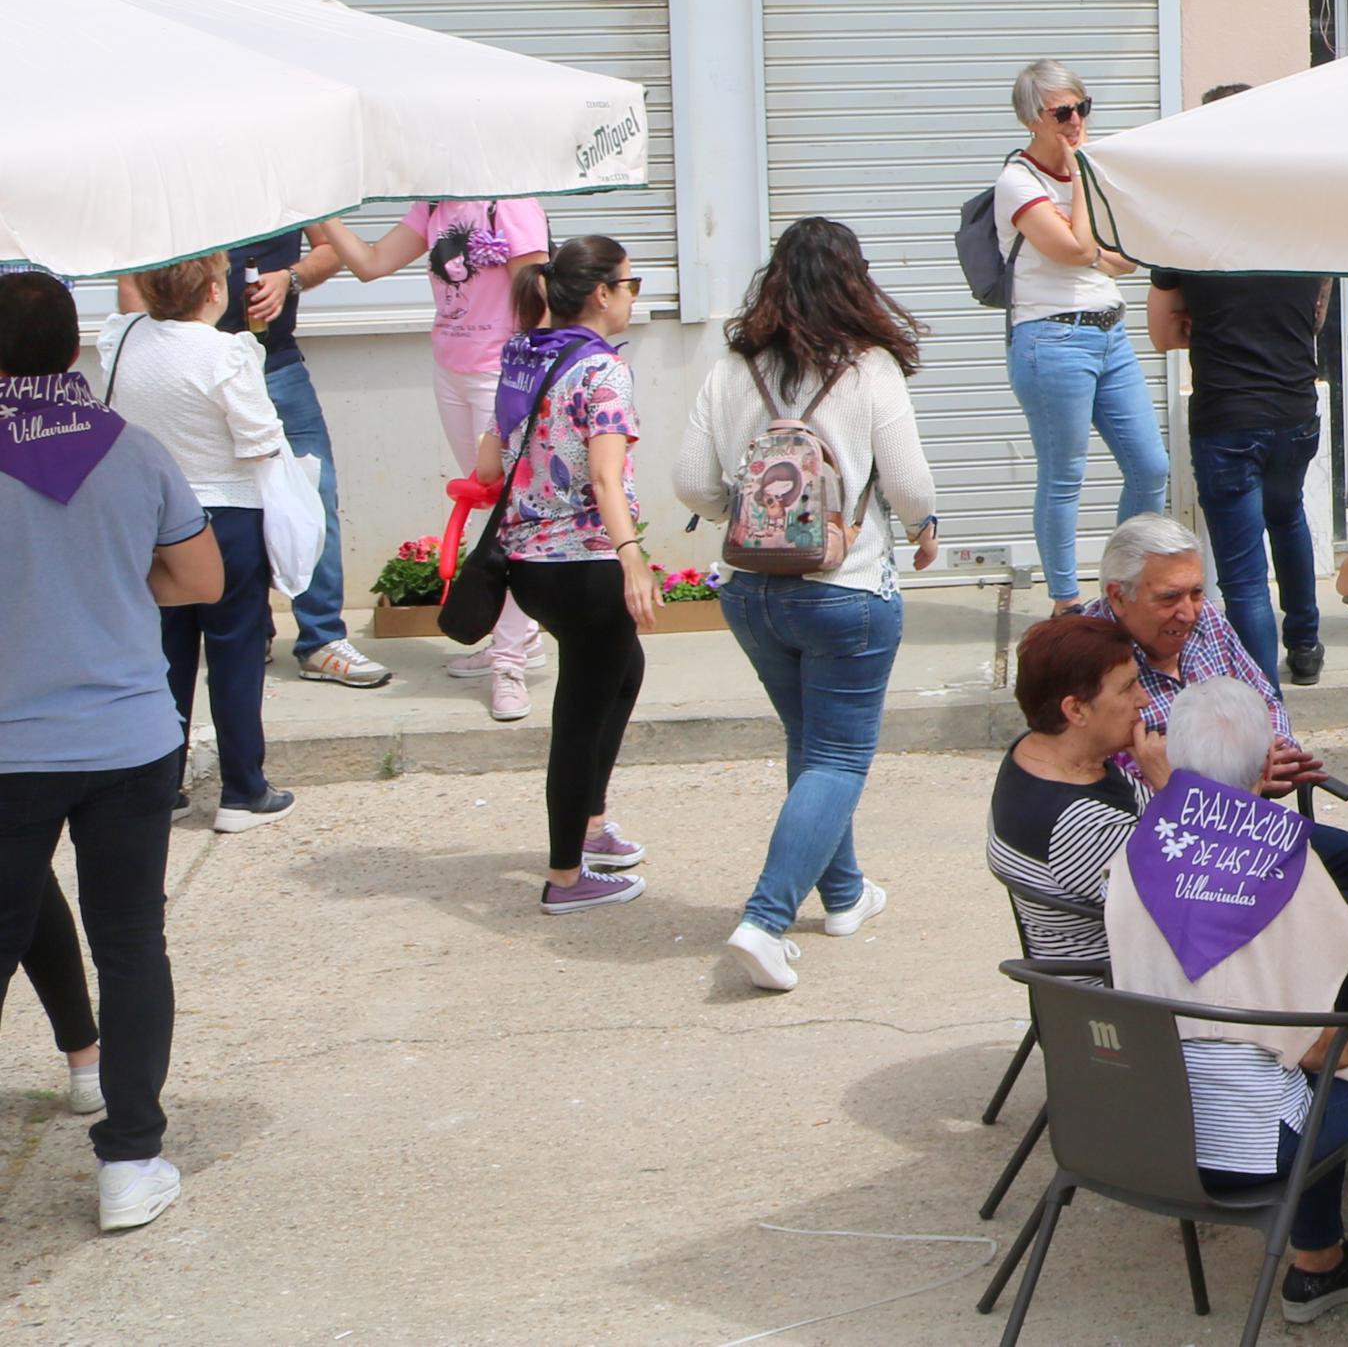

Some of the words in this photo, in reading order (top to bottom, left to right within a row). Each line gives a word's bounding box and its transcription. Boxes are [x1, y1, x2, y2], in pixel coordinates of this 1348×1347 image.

[8, 412, 92, 444] Villaviudas
[1180, 787, 1304, 853] EXALTACIÓN
[1191, 839, 1219, 867] DE
[1214, 846, 1251, 875] LAS
[1175, 872, 1257, 907] Villaviudas
